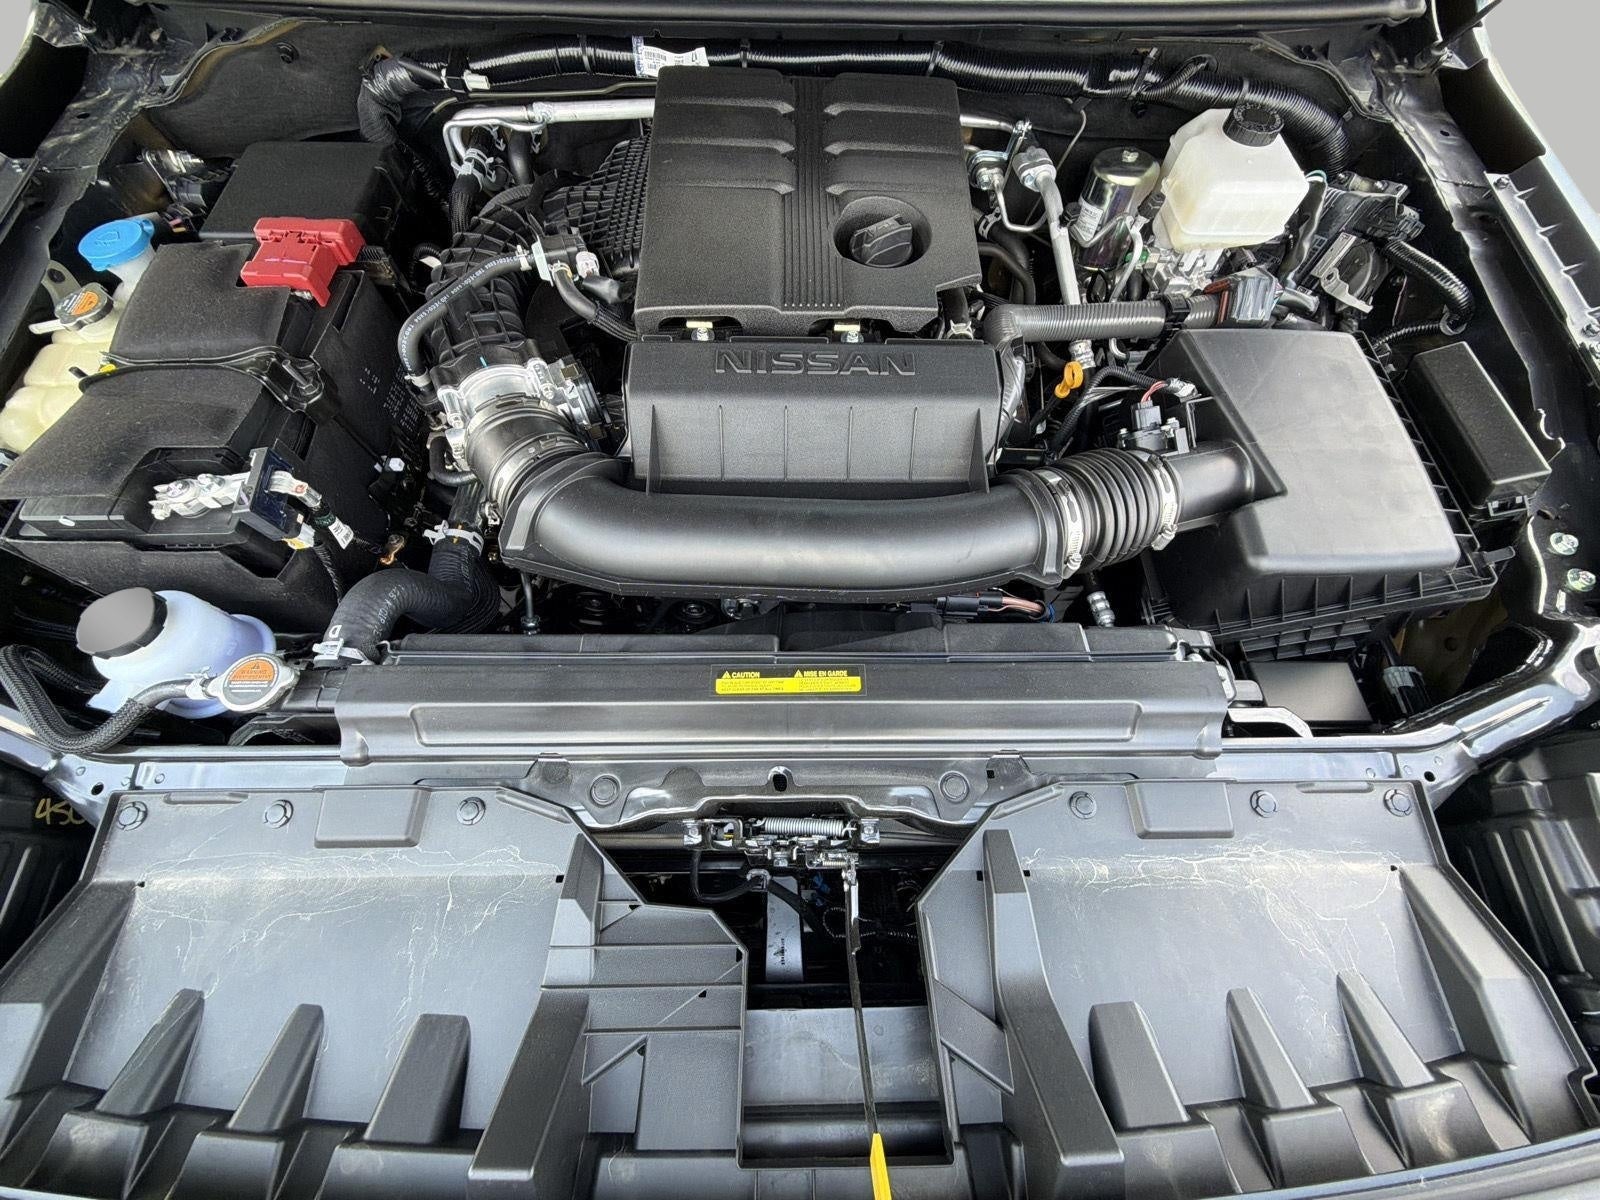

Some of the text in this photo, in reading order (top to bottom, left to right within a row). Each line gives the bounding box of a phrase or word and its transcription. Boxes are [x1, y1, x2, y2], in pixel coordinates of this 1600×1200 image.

[715, 350, 916, 375] NISSAN
[732, 671, 761, 679] CAUTION
[803, 670, 818, 678] MISE
[827, 669, 848, 677] GARDE
